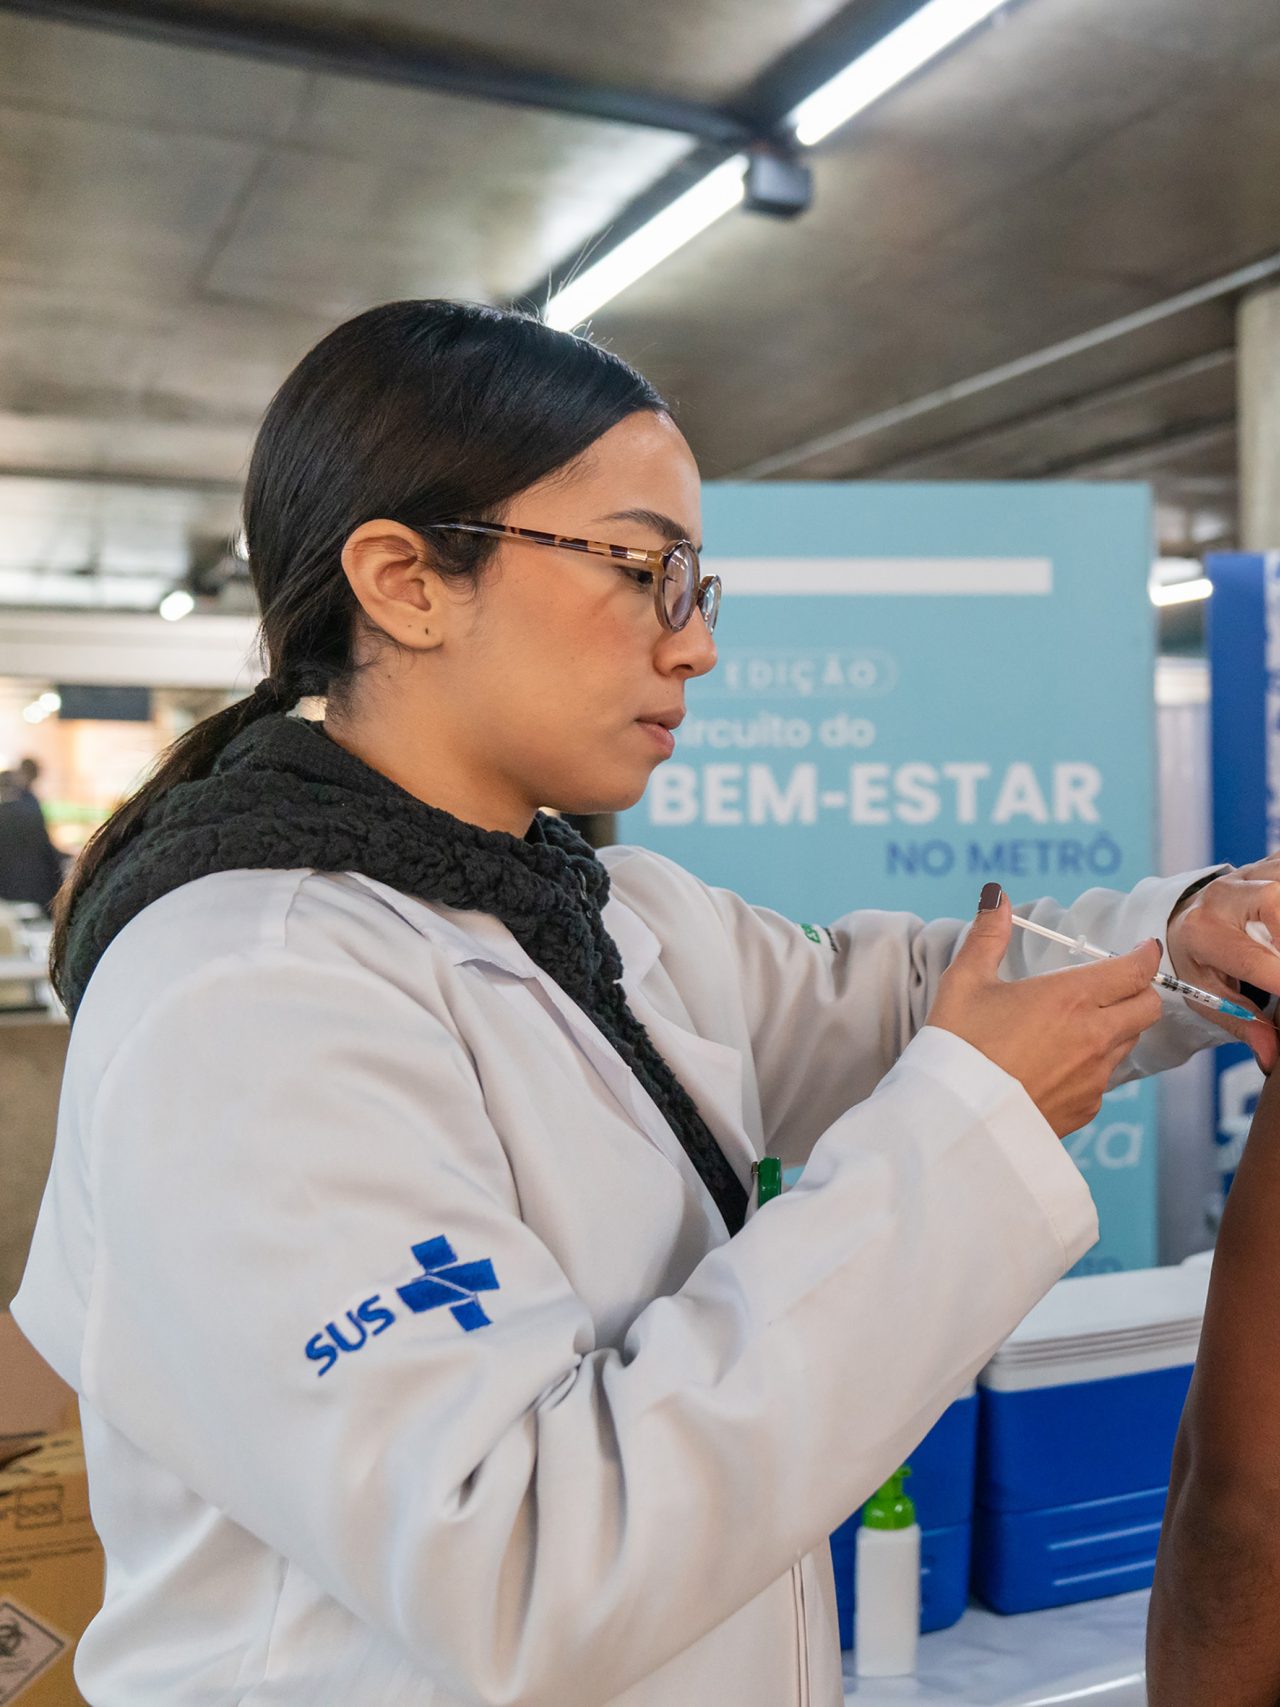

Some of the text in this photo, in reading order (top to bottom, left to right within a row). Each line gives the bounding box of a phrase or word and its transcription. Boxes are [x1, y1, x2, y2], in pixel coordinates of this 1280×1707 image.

[680, 711, 876, 748] ircuito do
[648, 762, 1104, 825] BEM-ESTAR
[886, 833, 1122, 876] NO METRÔ
[304, 1294, 396, 1378] SUS
